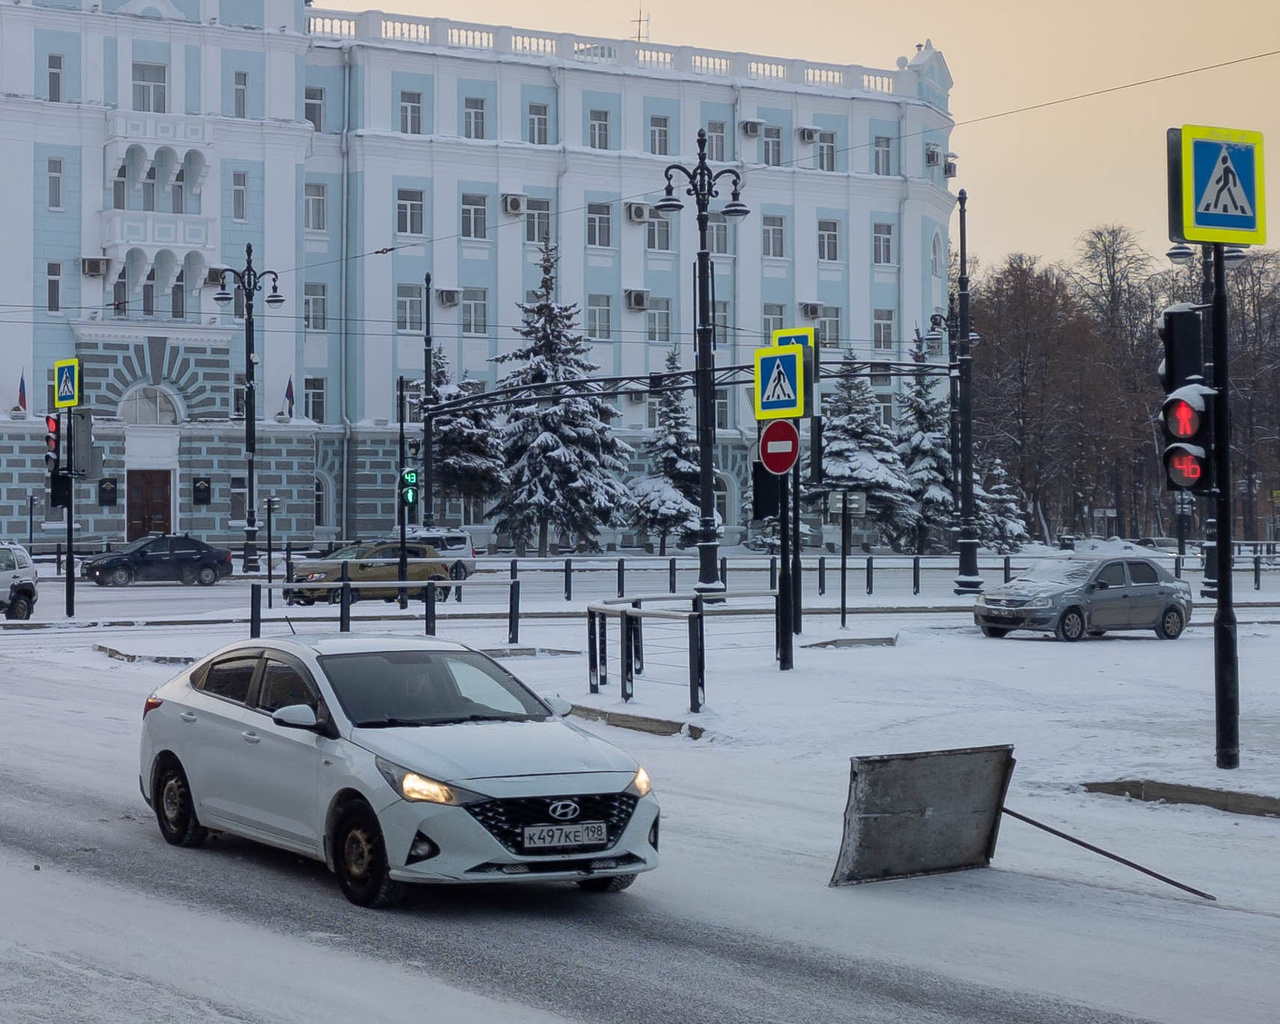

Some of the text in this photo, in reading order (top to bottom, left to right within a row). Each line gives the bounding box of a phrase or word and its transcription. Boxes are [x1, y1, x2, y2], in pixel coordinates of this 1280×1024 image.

[1174, 455, 1201, 478] 46
[404, 472, 417, 483] 43
[583, 825, 603, 838] 198
